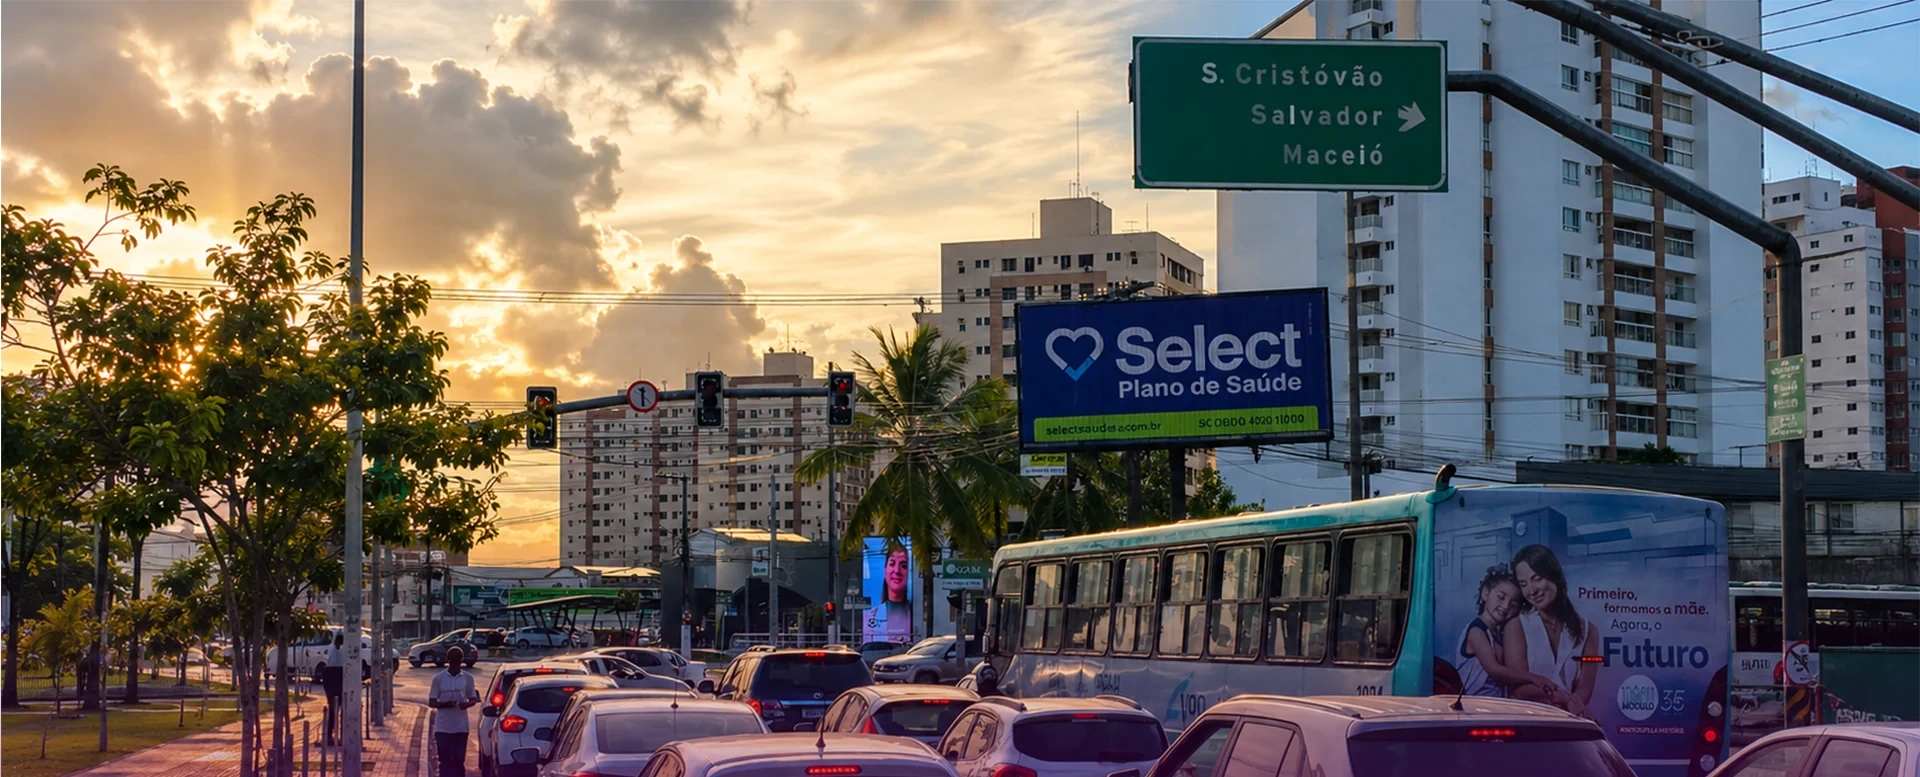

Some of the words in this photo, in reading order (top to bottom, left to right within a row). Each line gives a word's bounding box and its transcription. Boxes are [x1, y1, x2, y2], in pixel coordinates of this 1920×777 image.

[1202, 62, 1225, 84] S.
[1235, 63, 1383, 86] Cristóvão
[1251, 103, 1383, 126] Salvador
[1283, 143, 1383, 165] Maceió
[1115, 323, 1302, 376] Select
[1119, 378, 1184, 399] Plano
[1190, 376, 1220, 396] de
[1226, 372, 1302, 394] Saúde
[1578, 586, 1639, 600] Primeiro,
[1604, 602, 1662, 614] formamos
[1663, 605, 1672, 615] a
[1610, 618, 1652, 633] Agora,
[1654, 621, 1663, 631] o
[1603, 636, 1710, 669] Futuro
